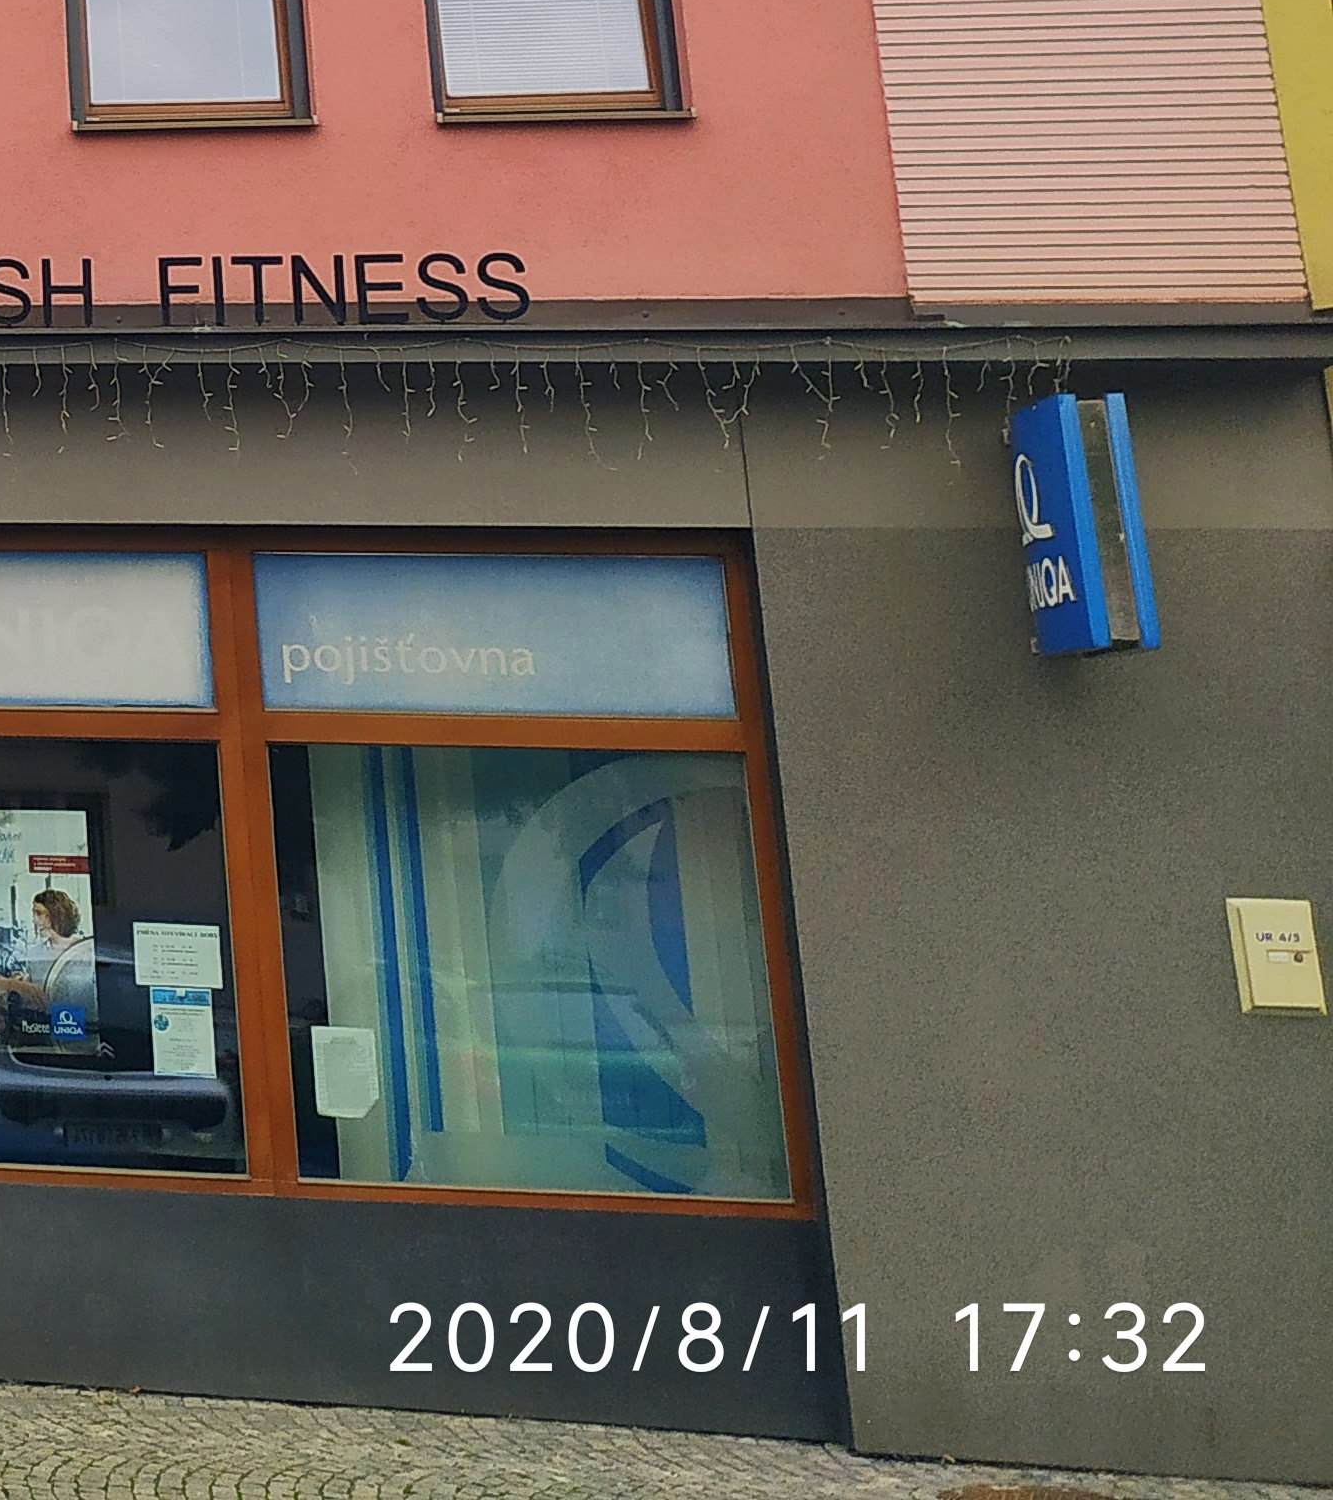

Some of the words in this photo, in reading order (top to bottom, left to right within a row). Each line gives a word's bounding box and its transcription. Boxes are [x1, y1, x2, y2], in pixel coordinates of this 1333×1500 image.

[158, 252, 530, 325] FITNESS
[282, 633, 536, 685] pojišťovna
[53, 1026, 83, 1035] UNIQA
